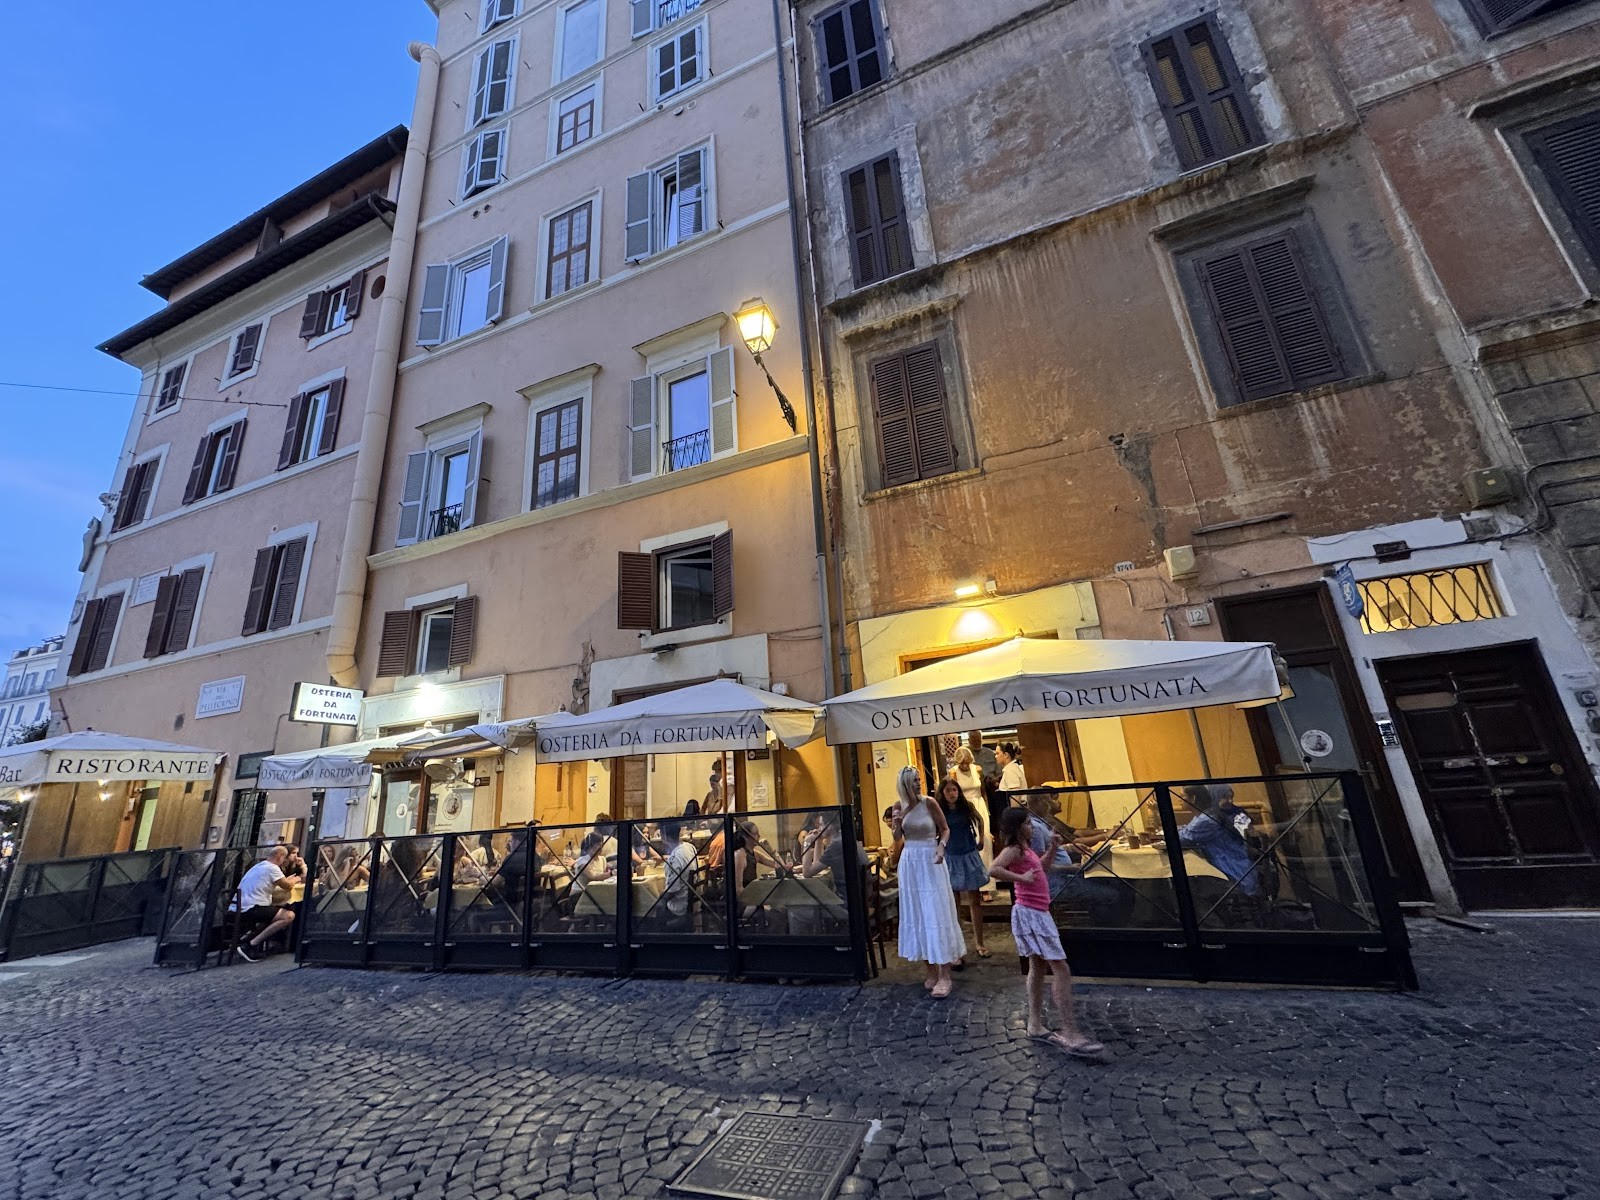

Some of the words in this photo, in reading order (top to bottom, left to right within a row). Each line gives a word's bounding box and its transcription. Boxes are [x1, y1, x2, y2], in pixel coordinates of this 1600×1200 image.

[1189, 610, 1204, 623] 12
[311, 687, 352, 699] OSTERIA
[1042, 675, 1208, 710] FORTUNATA
[323, 701, 337, 709] DA
[991, 696, 1025, 716] DA
[299, 709, 357, 721] FORTUNATA
[871, 700, 976, 732] OSTERIA
[620, 730, 643, 747] DA
[654, 723, 760, 744] FORTUNATA
[540, 731, 610, 754] OSTERIA
[0, 765, 21, 783] Bar
[56, 758, 209, 774] RISTORANTE
[261, 768, 296, 780] OSTERIA
